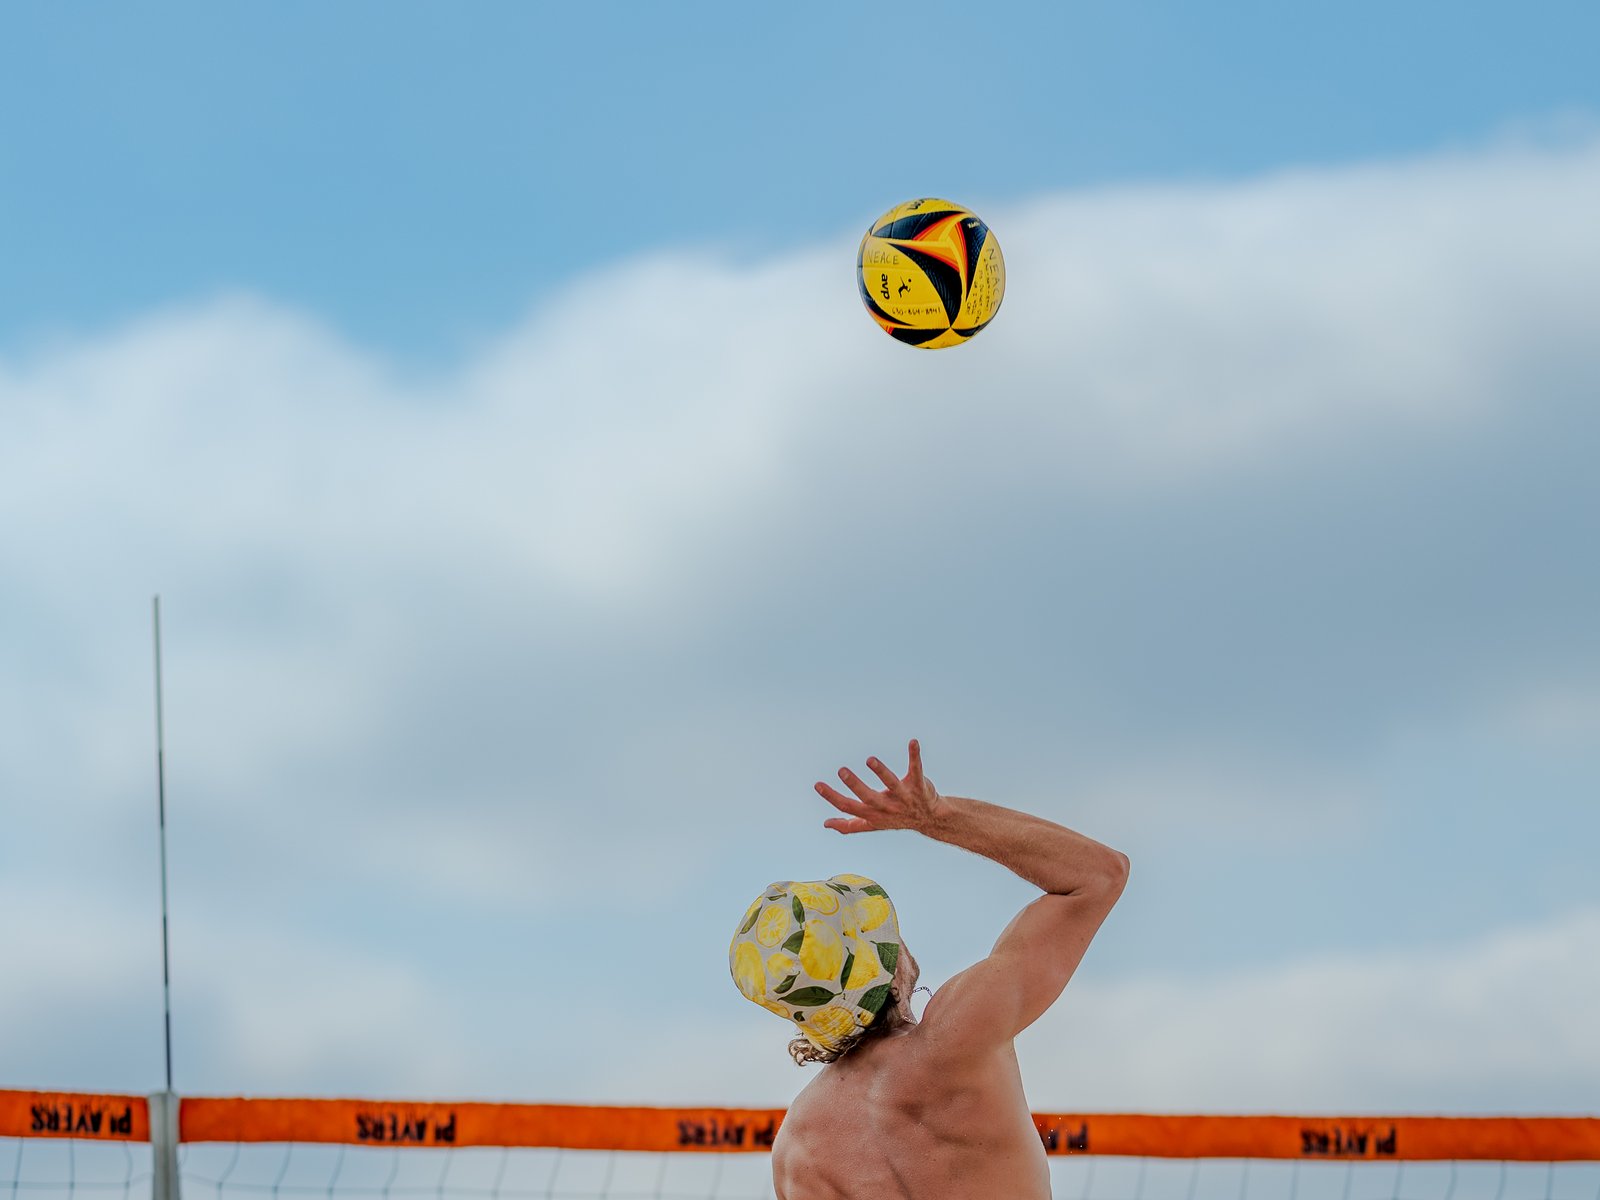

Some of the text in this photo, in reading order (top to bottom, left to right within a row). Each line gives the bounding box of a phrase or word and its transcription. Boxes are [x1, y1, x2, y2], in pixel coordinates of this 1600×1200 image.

[880, 273, 890, 300] avp
[31, 1104, 132, 1134] PLAYERS
[355, 1112, 457, 1142] PLAYERS
[1301, 1124, 1396, 1154] PLAYERS
